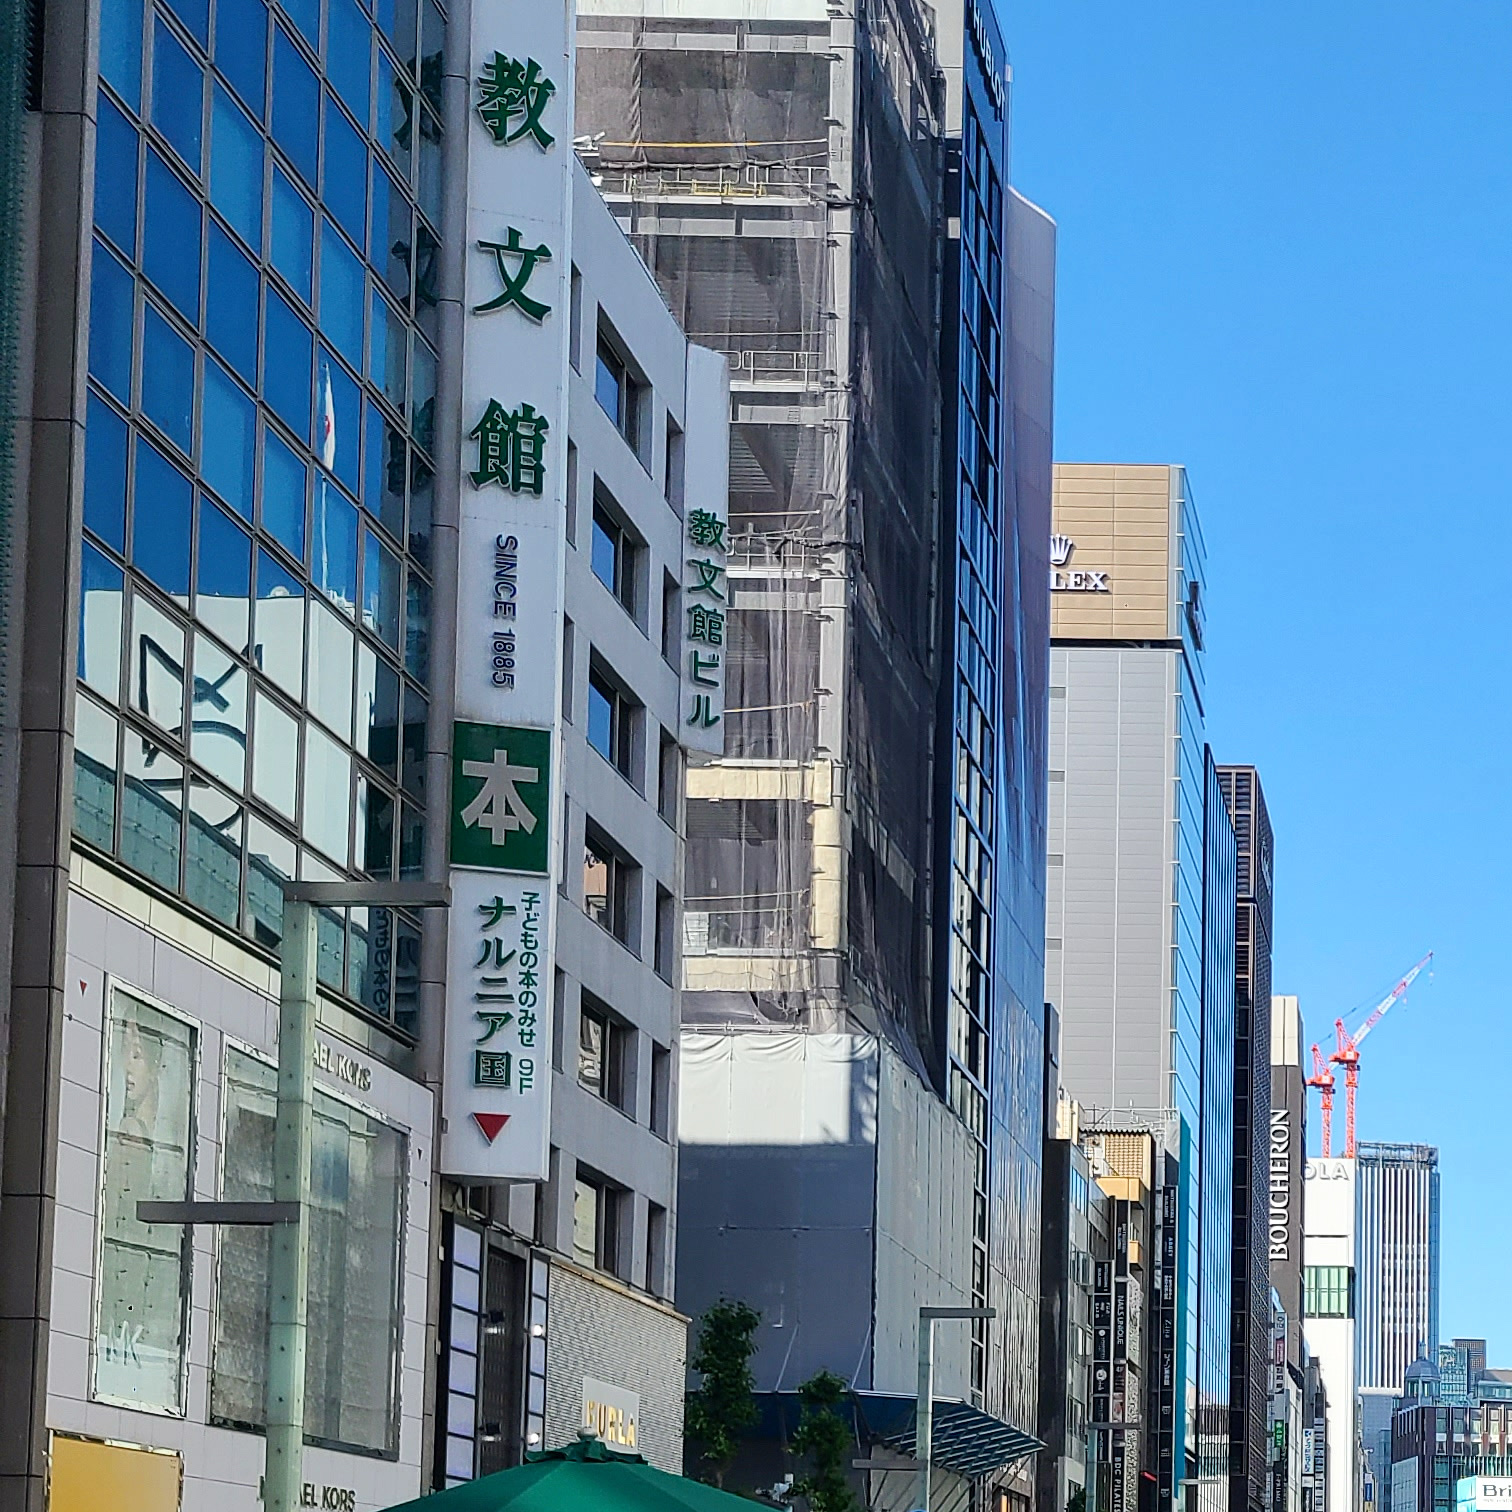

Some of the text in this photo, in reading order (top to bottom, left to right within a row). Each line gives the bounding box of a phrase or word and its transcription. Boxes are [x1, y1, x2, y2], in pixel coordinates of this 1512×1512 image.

[468, 51, 557, 497] 教文館
[491, 534, 518, 690] SINCE 1885
[687, 508, 727, 728] 教文館ビル
[461, 748, 539, 845] 本
[473, 896, 517, 1088] ナルニア国
[518, 891, 541, 1095] 子どもの本のみせ 9F
[1269, 1109, 1290, 1262] BOUCHERON
[321, 1485, 356, 1512] KORS
